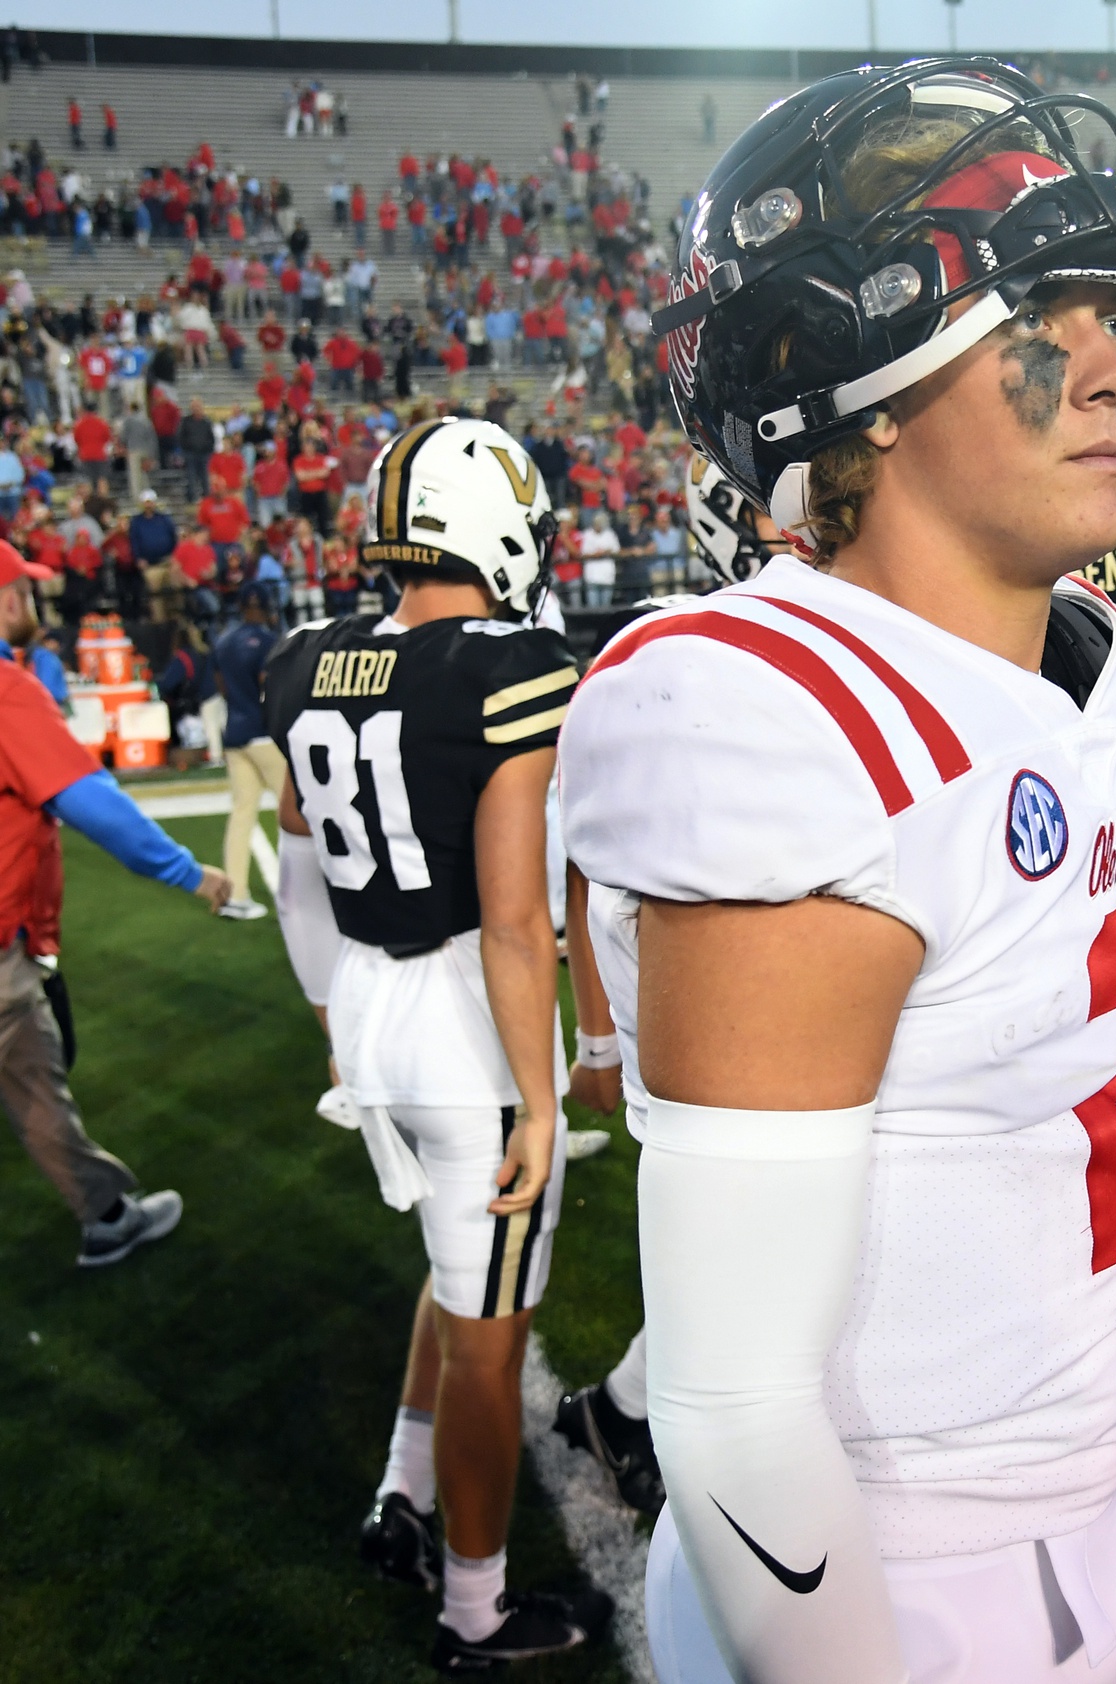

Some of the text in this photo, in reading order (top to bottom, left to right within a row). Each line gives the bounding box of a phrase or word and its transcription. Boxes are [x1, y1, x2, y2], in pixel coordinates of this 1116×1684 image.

[311, 649, 398, 698] BAIRD
[287, 709, 432, 891] 81
[1011, 776, 1065, 874] SEC
[1088, 820, 1116, 898] Ole
